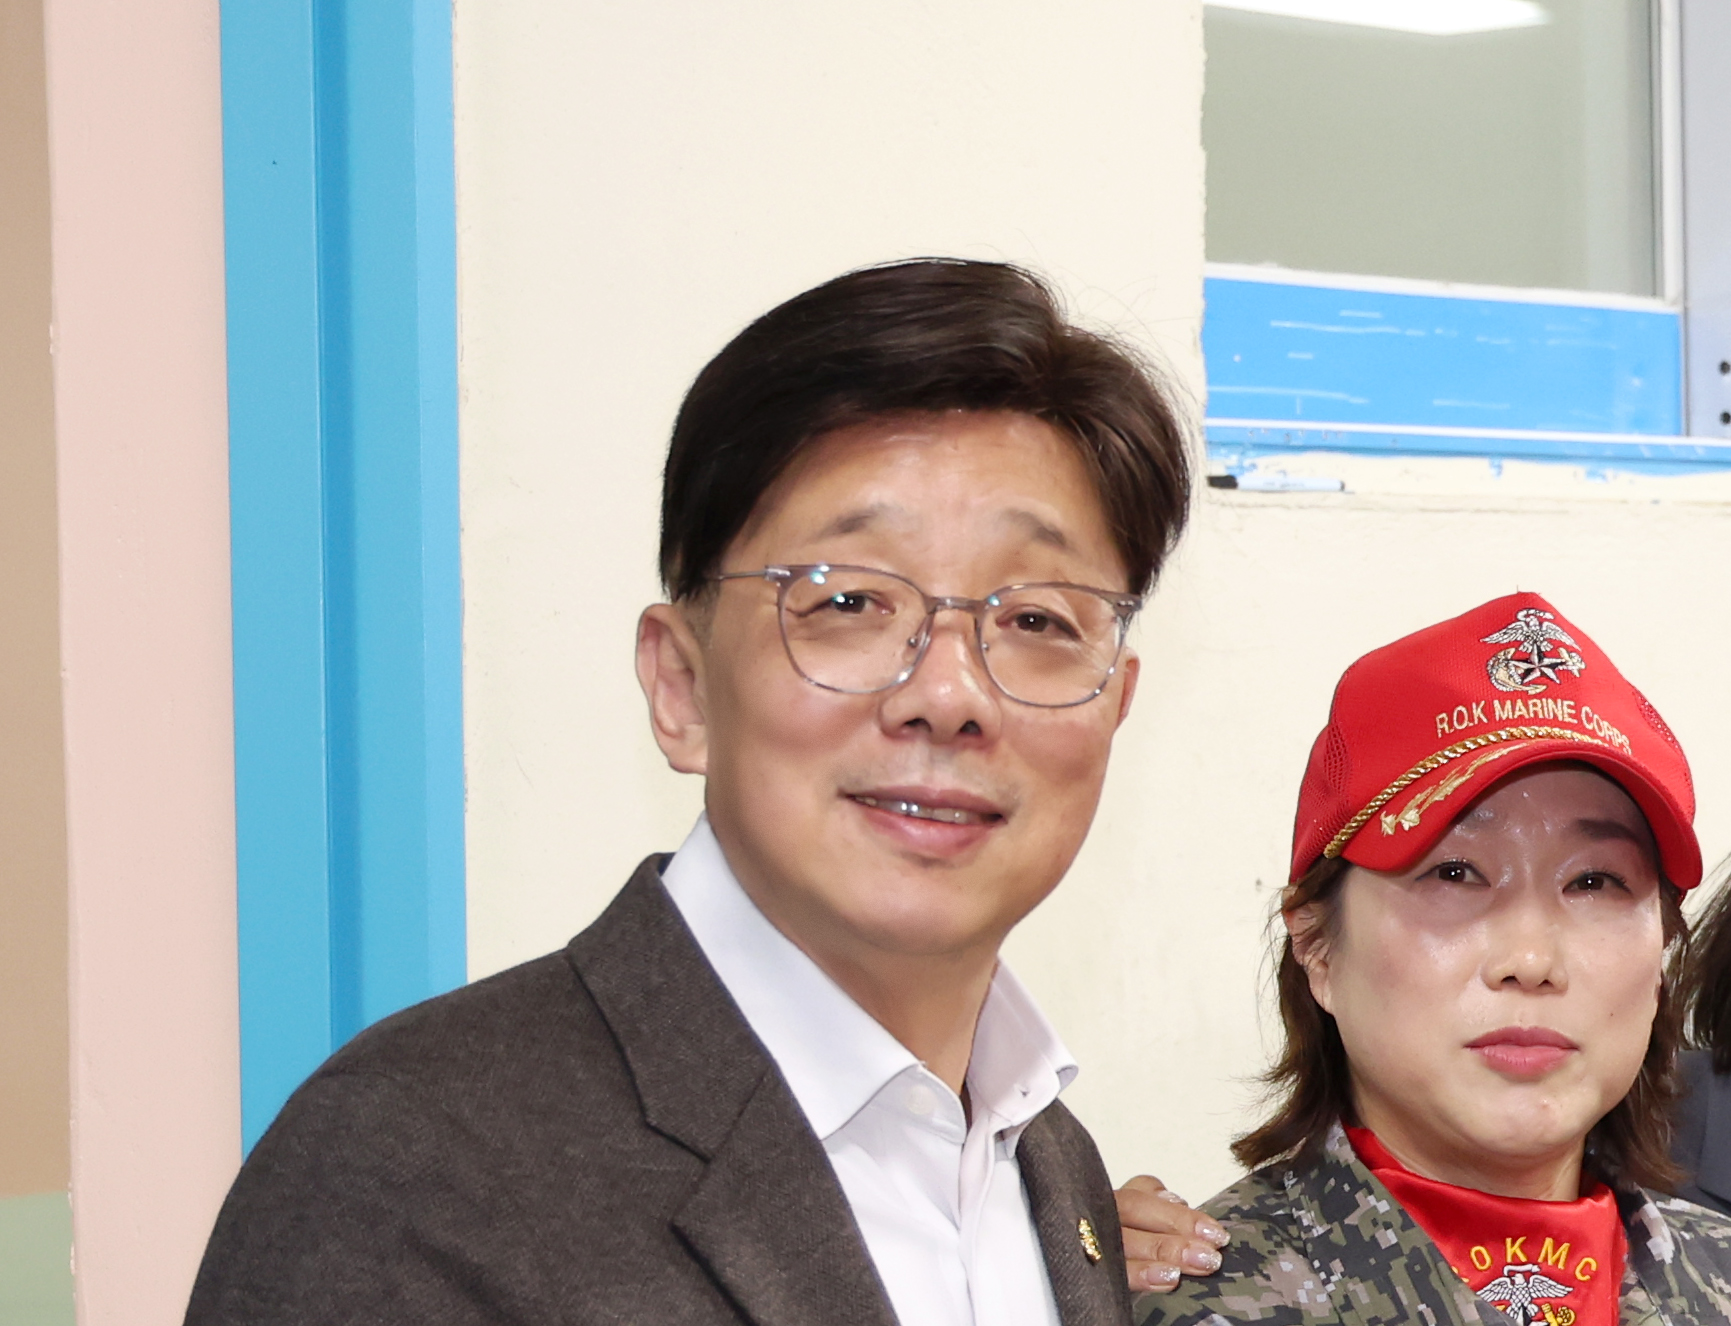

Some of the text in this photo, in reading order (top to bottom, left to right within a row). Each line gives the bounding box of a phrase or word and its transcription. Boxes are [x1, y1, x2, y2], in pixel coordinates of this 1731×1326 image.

[1435, 698, 1633, 756] R.O.K MARINE CORPS
[1451, 1236, 1598, 1282] OKMC
